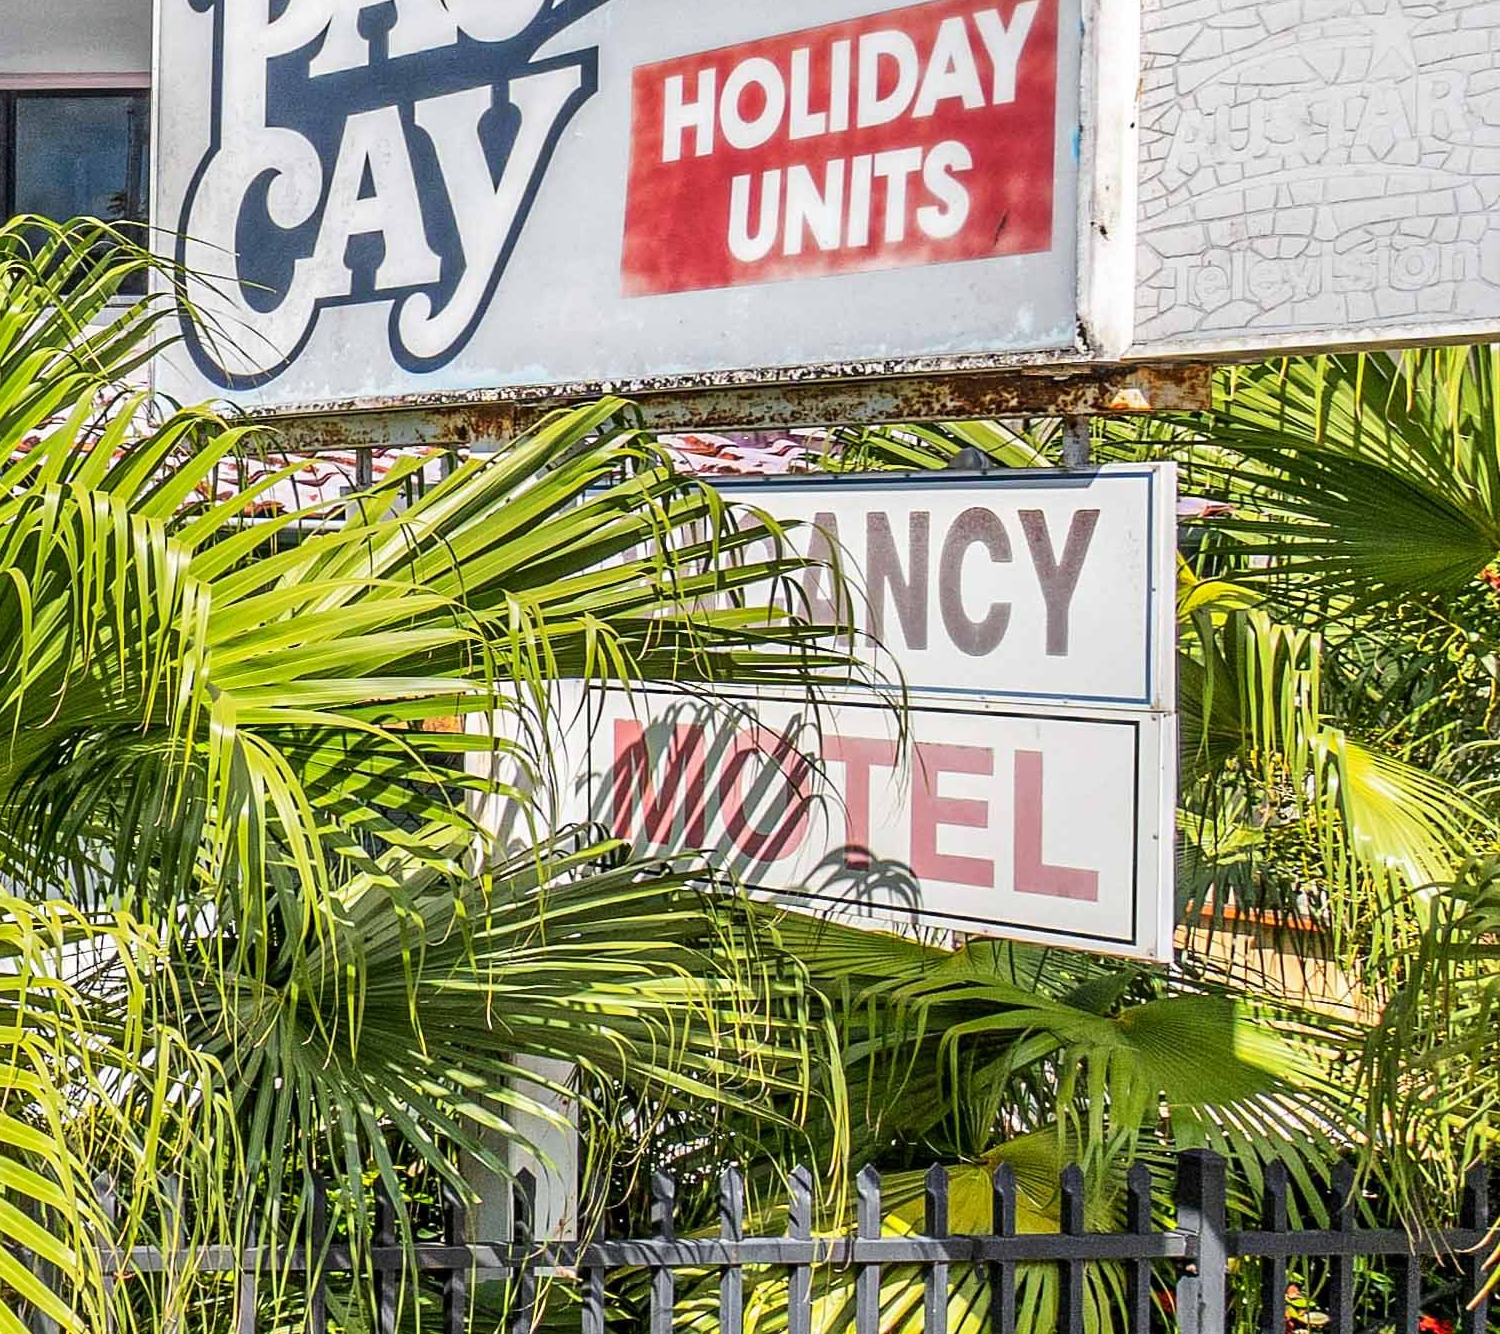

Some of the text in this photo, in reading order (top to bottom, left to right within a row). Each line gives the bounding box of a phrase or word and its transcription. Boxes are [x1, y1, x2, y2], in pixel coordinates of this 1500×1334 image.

[661, 0, 1040, 165] HOLIDAY
[175, 45, 599, 391] CAY
[726, 140, 972, 262] UNITS
[612, 505, 1101, 657] ANCY
[612, 718, 1100, 903] MOTEL
